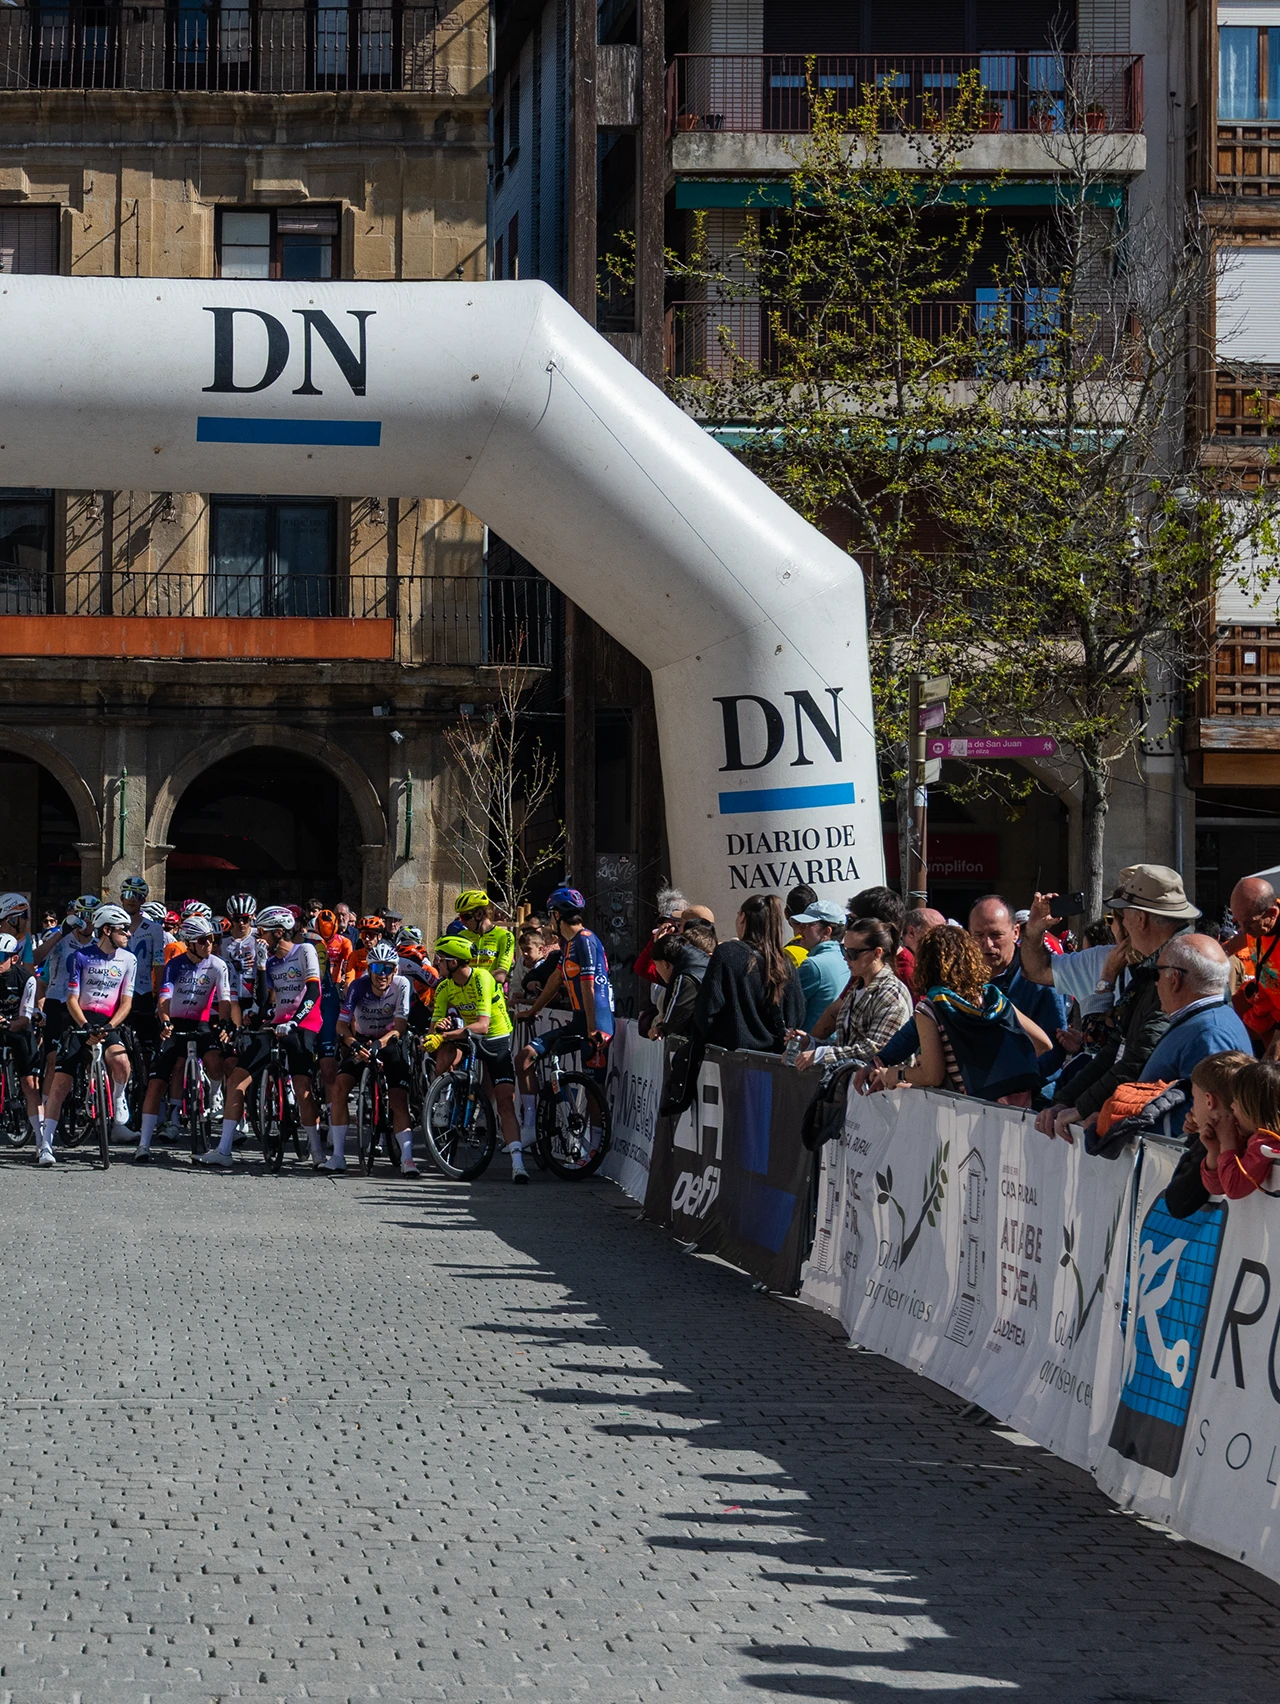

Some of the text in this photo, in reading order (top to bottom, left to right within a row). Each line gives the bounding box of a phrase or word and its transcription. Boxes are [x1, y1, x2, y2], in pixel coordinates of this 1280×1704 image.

[202, 306, 377, 396] DN
[712, 686, 844, 772] DN
[974, 740, 985, 748] de
[986, 740, 1001, 748] San
[1002, 740, 1022, 748] Juan
[726, 824, 856, 856] DIARIO DE
[728, 856, 861, 890] NAVARRA
